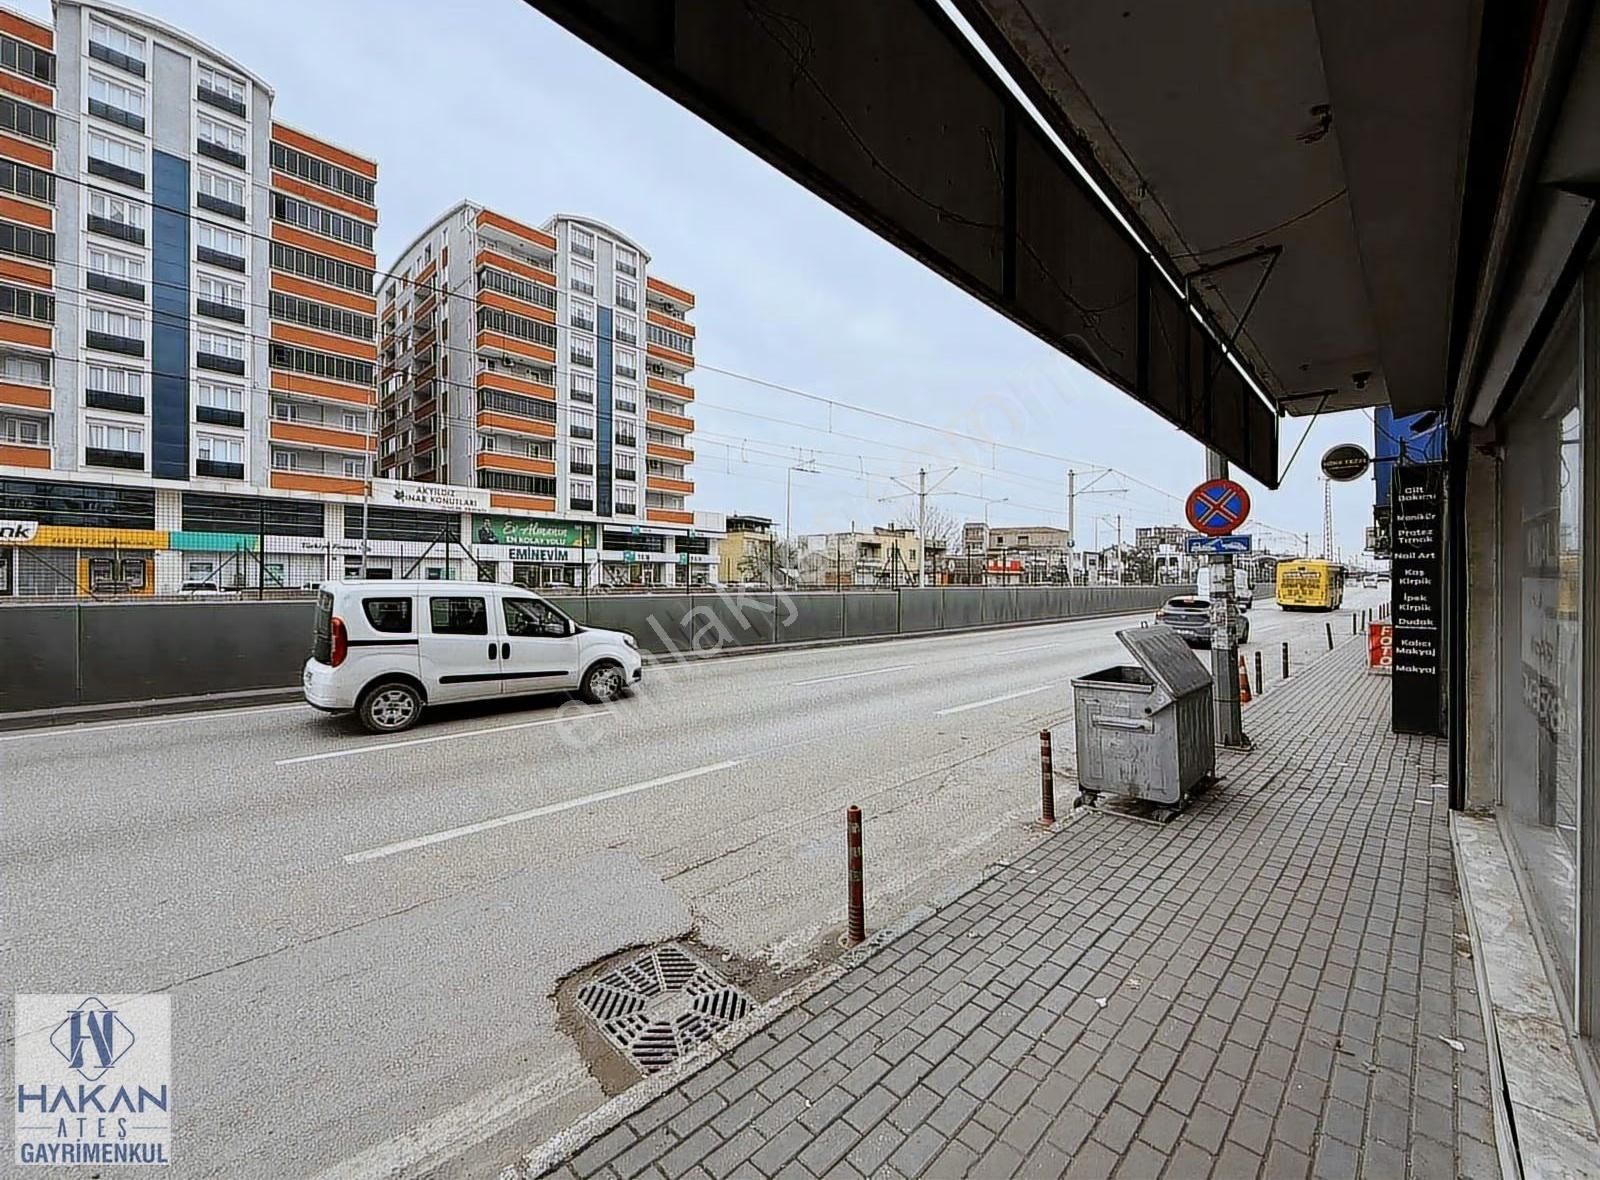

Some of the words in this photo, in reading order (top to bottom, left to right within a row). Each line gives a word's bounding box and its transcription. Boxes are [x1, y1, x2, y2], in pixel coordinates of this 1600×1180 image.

[508, 548, 569, 561] EMİNEVİM
[1396, 647, 1436, 657] Makyaj
[1396, 665, 1436, 675] Makyaj
